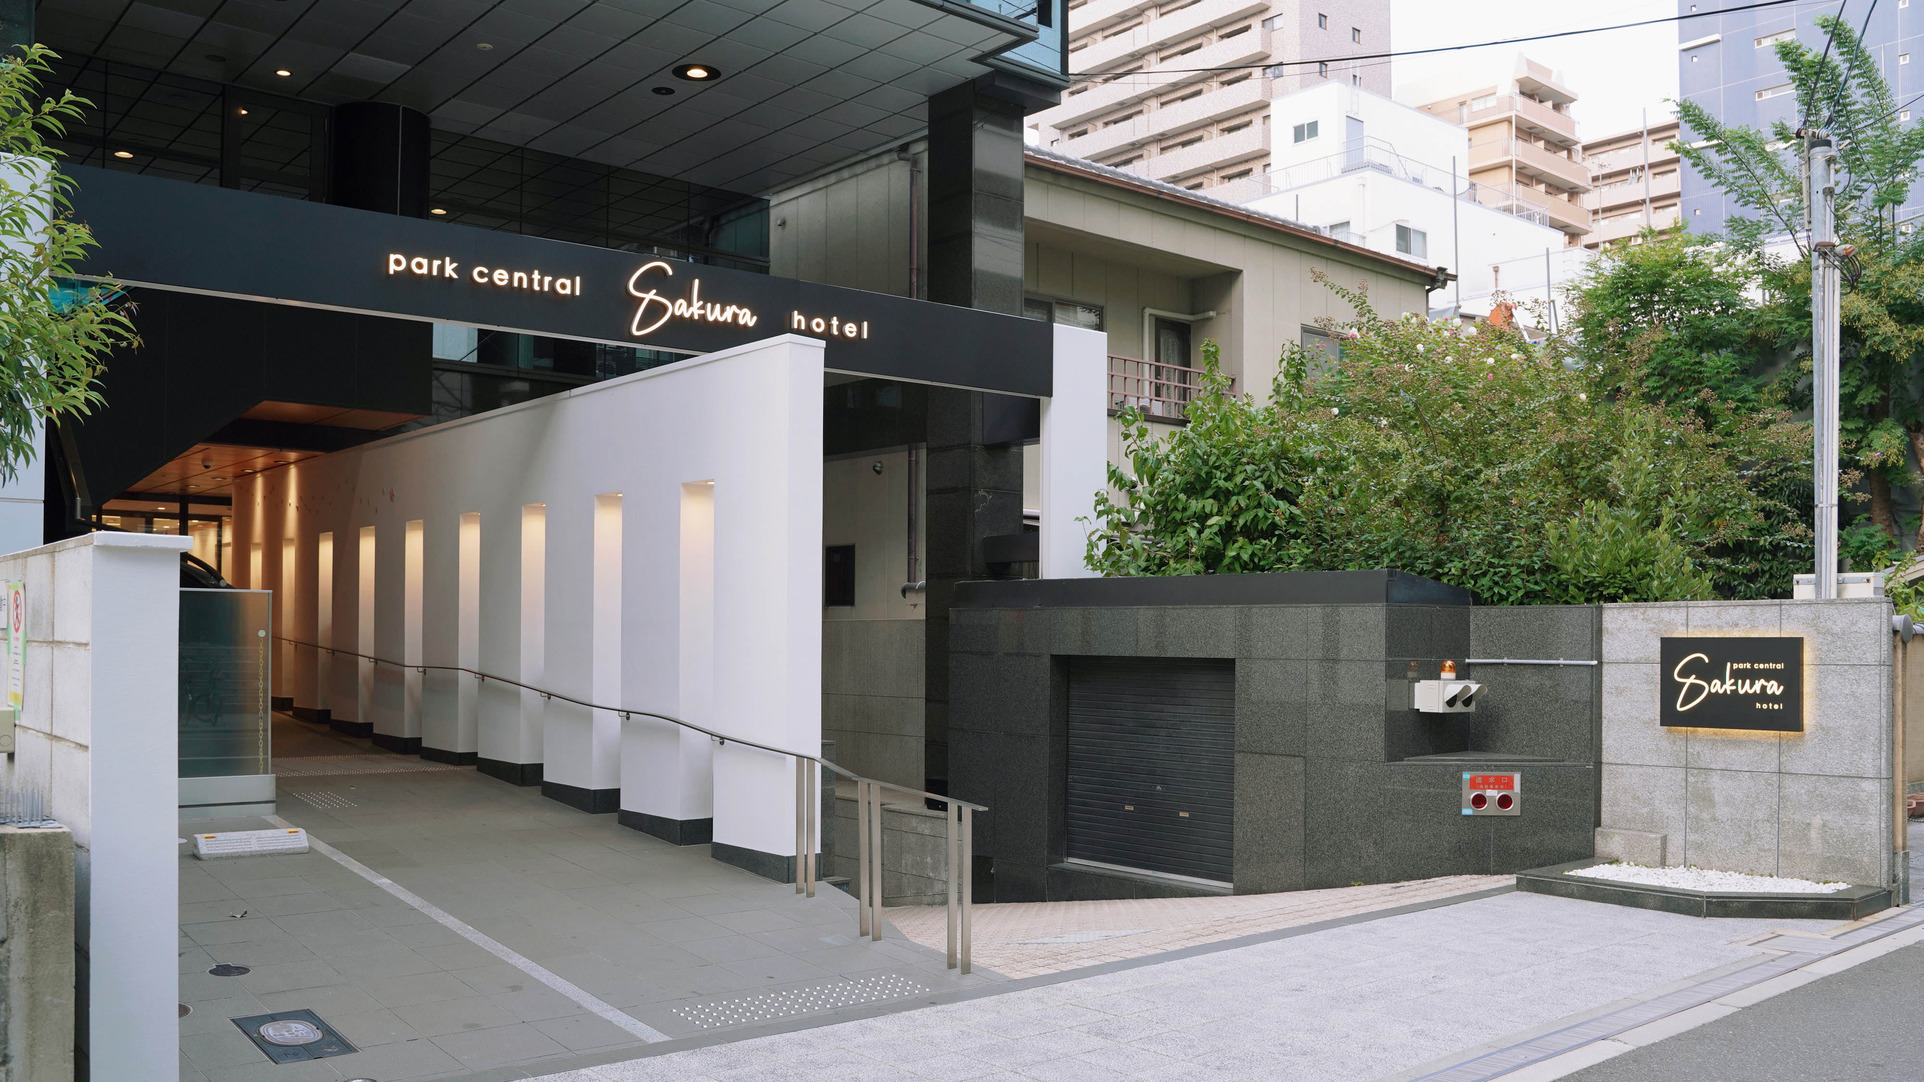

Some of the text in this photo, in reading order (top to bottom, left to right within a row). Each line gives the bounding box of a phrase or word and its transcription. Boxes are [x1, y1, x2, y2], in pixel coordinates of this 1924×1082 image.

[388, 253, 869, 340] park central Sakura hotel
[1673, 652, 1785, 712] Sakura
[1733, 662, 1785, 670] park central
[1755, 702, 1784, 710] hotel
